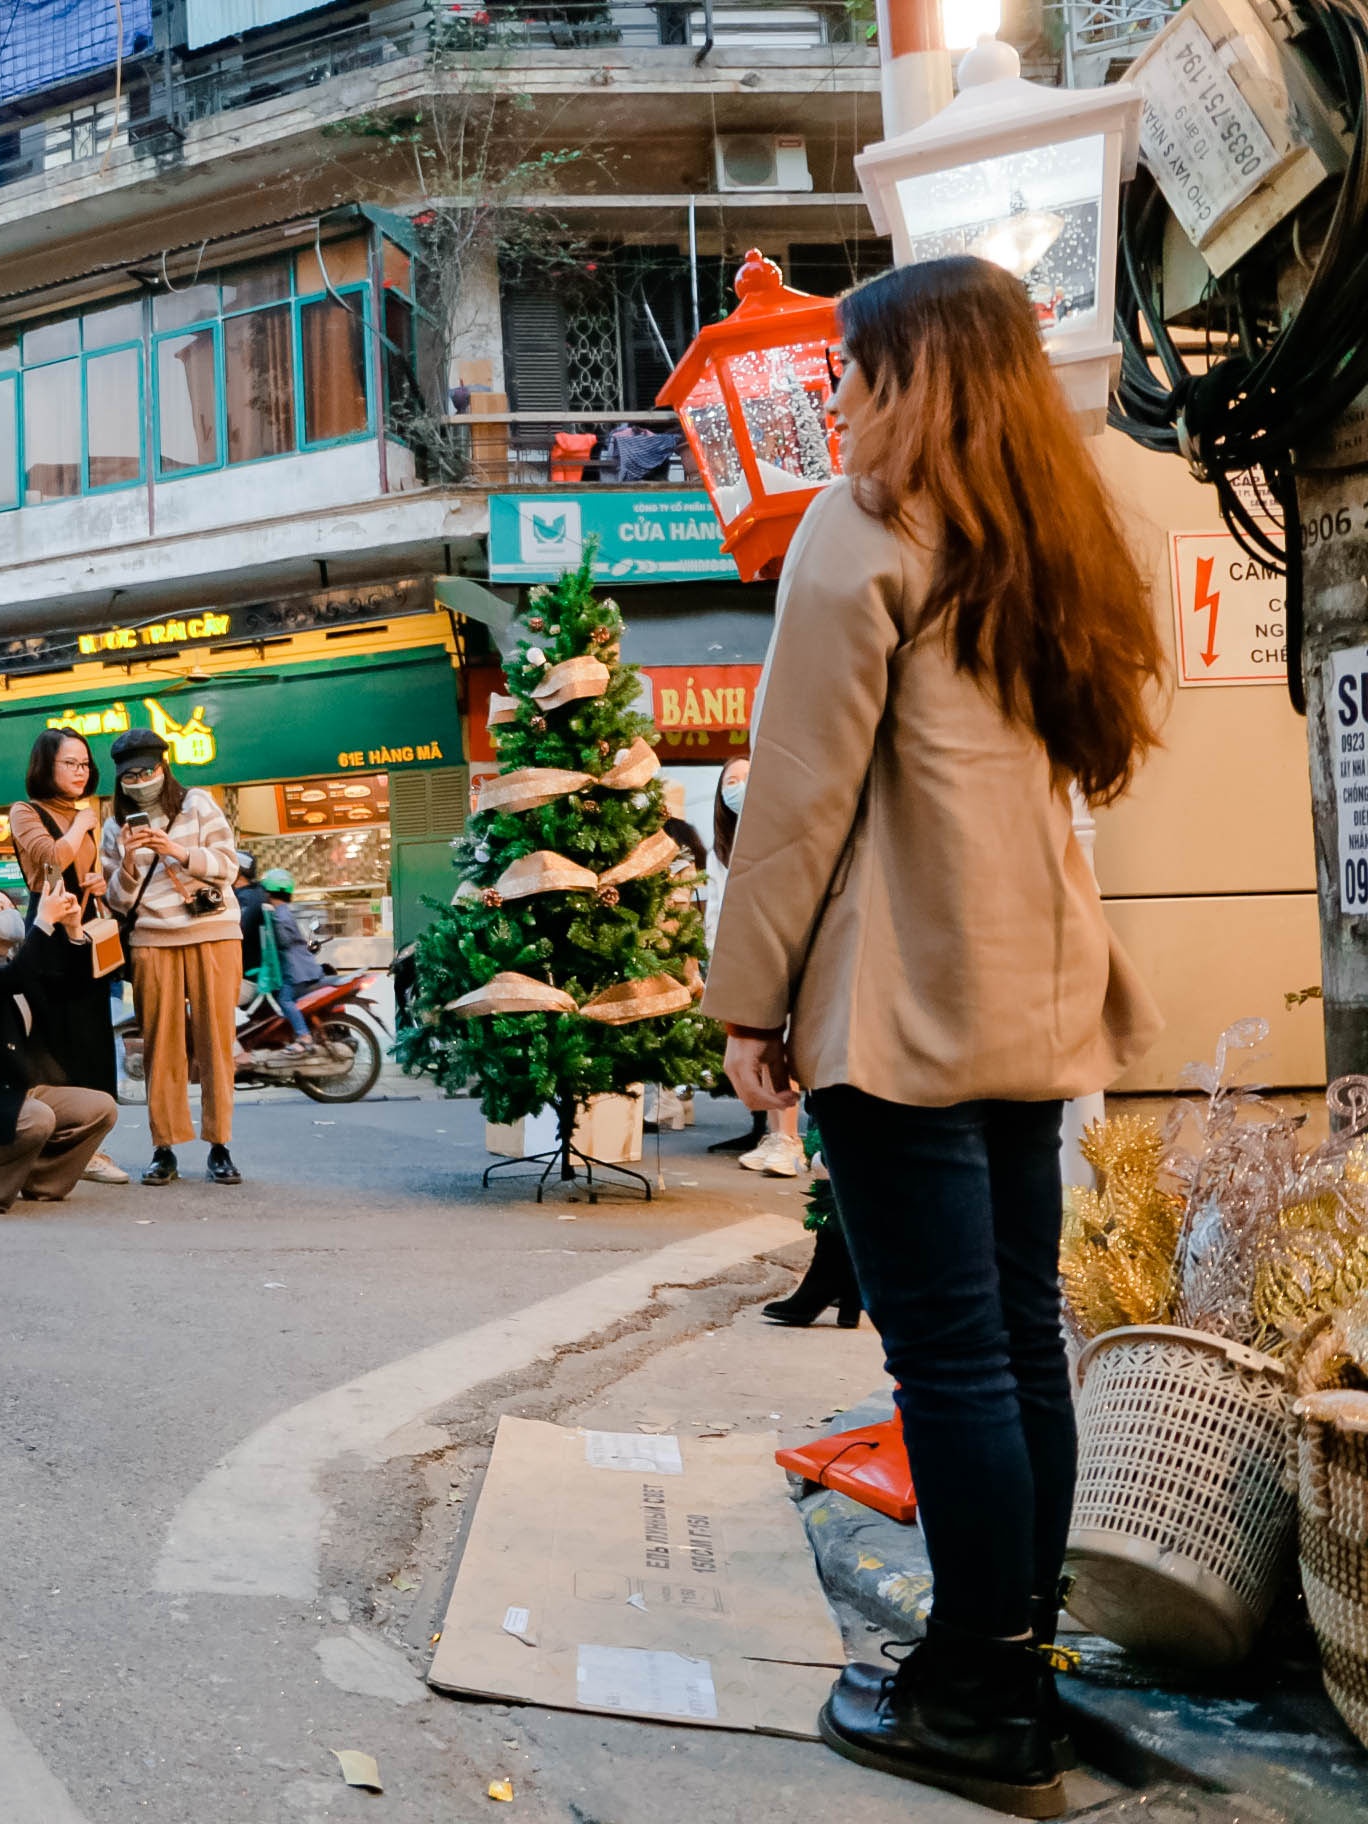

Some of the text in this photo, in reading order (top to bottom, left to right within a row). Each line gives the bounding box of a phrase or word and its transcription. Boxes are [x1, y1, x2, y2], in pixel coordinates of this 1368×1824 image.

[1193, 138, 1210, 161] 10
[1169, 154, 1192, 188] VAY
[1187, 185, 1211, 221] CHO
[618, 515, 666, 542] CỬA
[660, 676, 746, 726] BÁNH
[368, 745, 415, 765] HÀNG
[416, 740, 443, 761] MÃ
[1341, 732, 1365, 753] 0923
